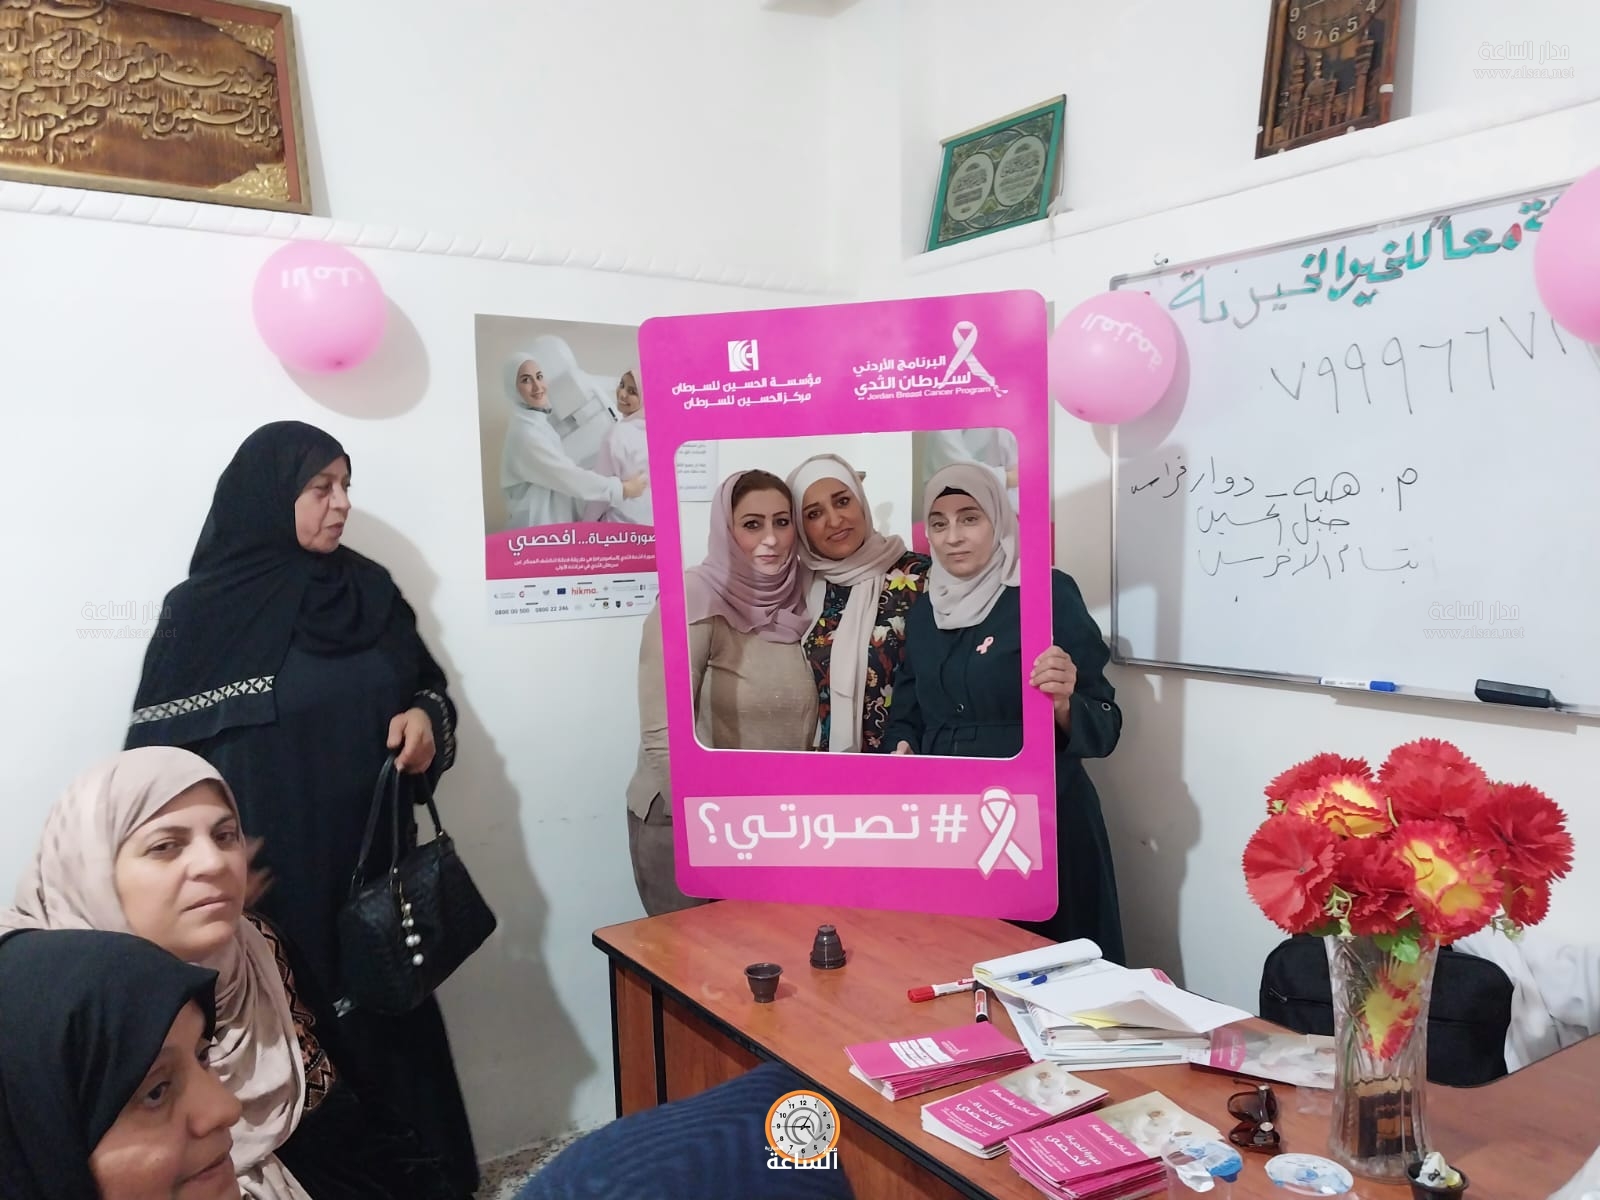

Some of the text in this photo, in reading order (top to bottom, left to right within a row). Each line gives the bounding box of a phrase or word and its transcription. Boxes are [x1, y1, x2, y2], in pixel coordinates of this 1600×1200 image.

[1289, 7, 1300, 22] 9
[1296, 25, 1307, 41] 8
[1346, 16, 1359, 33] 5
[1314, 30, 1323, 46] 7
[1328, 27, 1340, 43] 6
[852, 355, 947, 377] البرنامج الأردني
[671, 373, 822, 395] مؤسسة الحسين للسرطان
[854, 371, 972, 400] لسرطان الثدي
[683, 391, 812, 410] مركز الحسين للسرطان
[867, 385, 991, 401] Jordan Breast Cancer Program
[508, 528, 576, 557] افحصي
[630, 531, 657, 546] صورة
[698, 802, 920, 861] تصورتي؟
